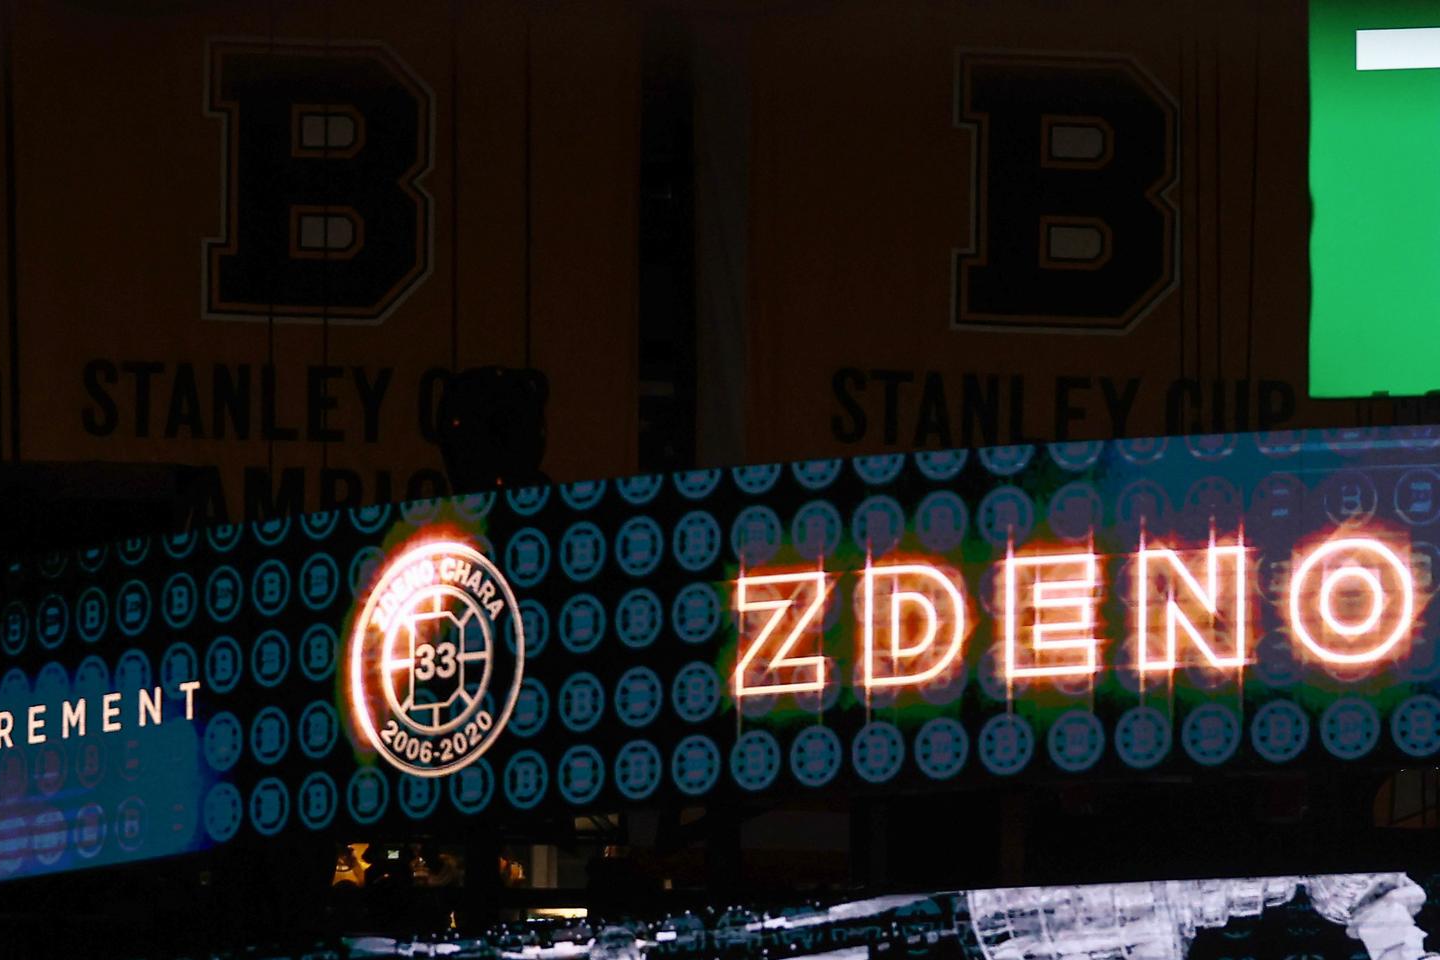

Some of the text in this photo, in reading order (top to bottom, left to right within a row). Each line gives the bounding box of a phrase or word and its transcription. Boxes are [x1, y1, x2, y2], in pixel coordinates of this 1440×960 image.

[81, 358, 393, 443] STANLEY
[831, 366, 1142, 446] STANLEY
[439, 556, 506, 622] CHARA
[734, 536, 1414, 696] ZDENO
[414, 641, 458, 681] 33
[380, 709, 493, 764] 2006-2020
